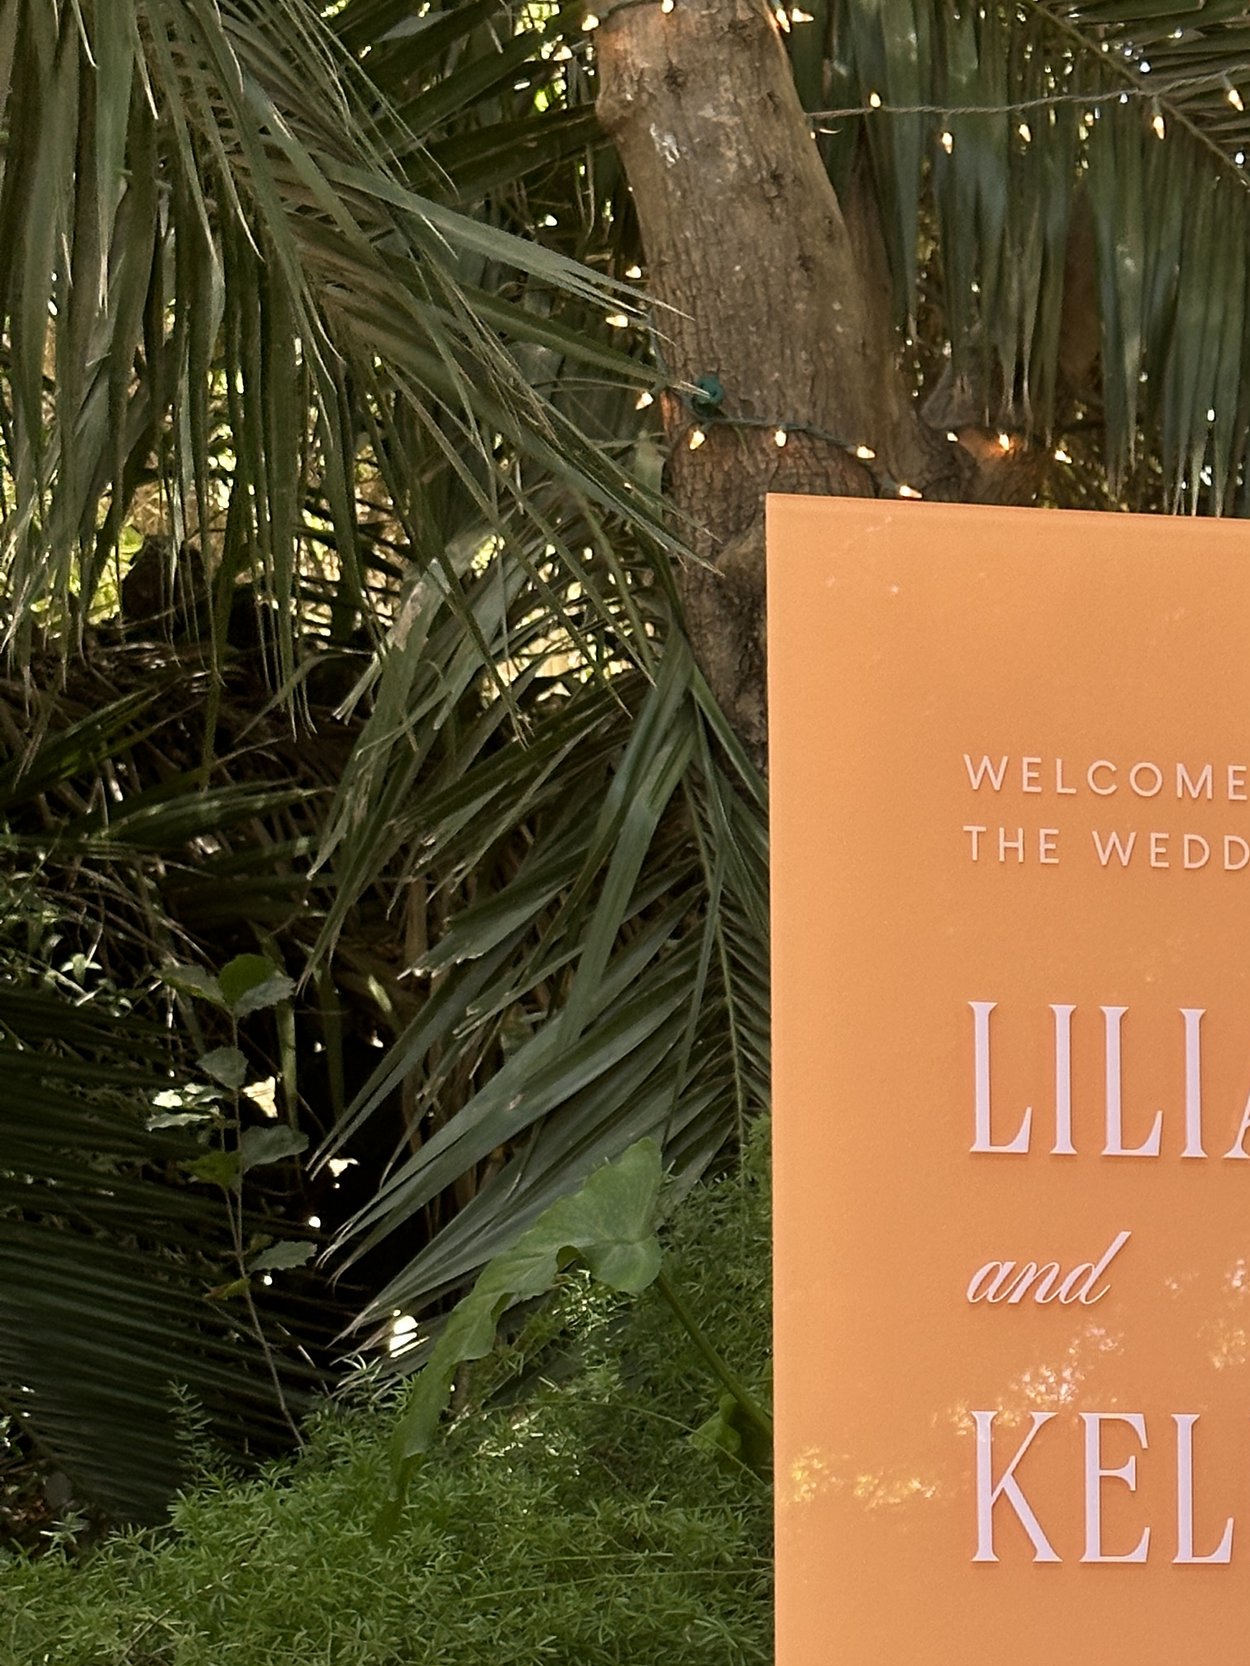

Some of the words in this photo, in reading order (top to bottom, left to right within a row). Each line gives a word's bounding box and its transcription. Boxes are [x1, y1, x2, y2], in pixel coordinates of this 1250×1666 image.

[963, 753, 1248, 801] WELCOME
[962, 825, 1060, 865] THE
[966, 1230, 1132, 1305] and
